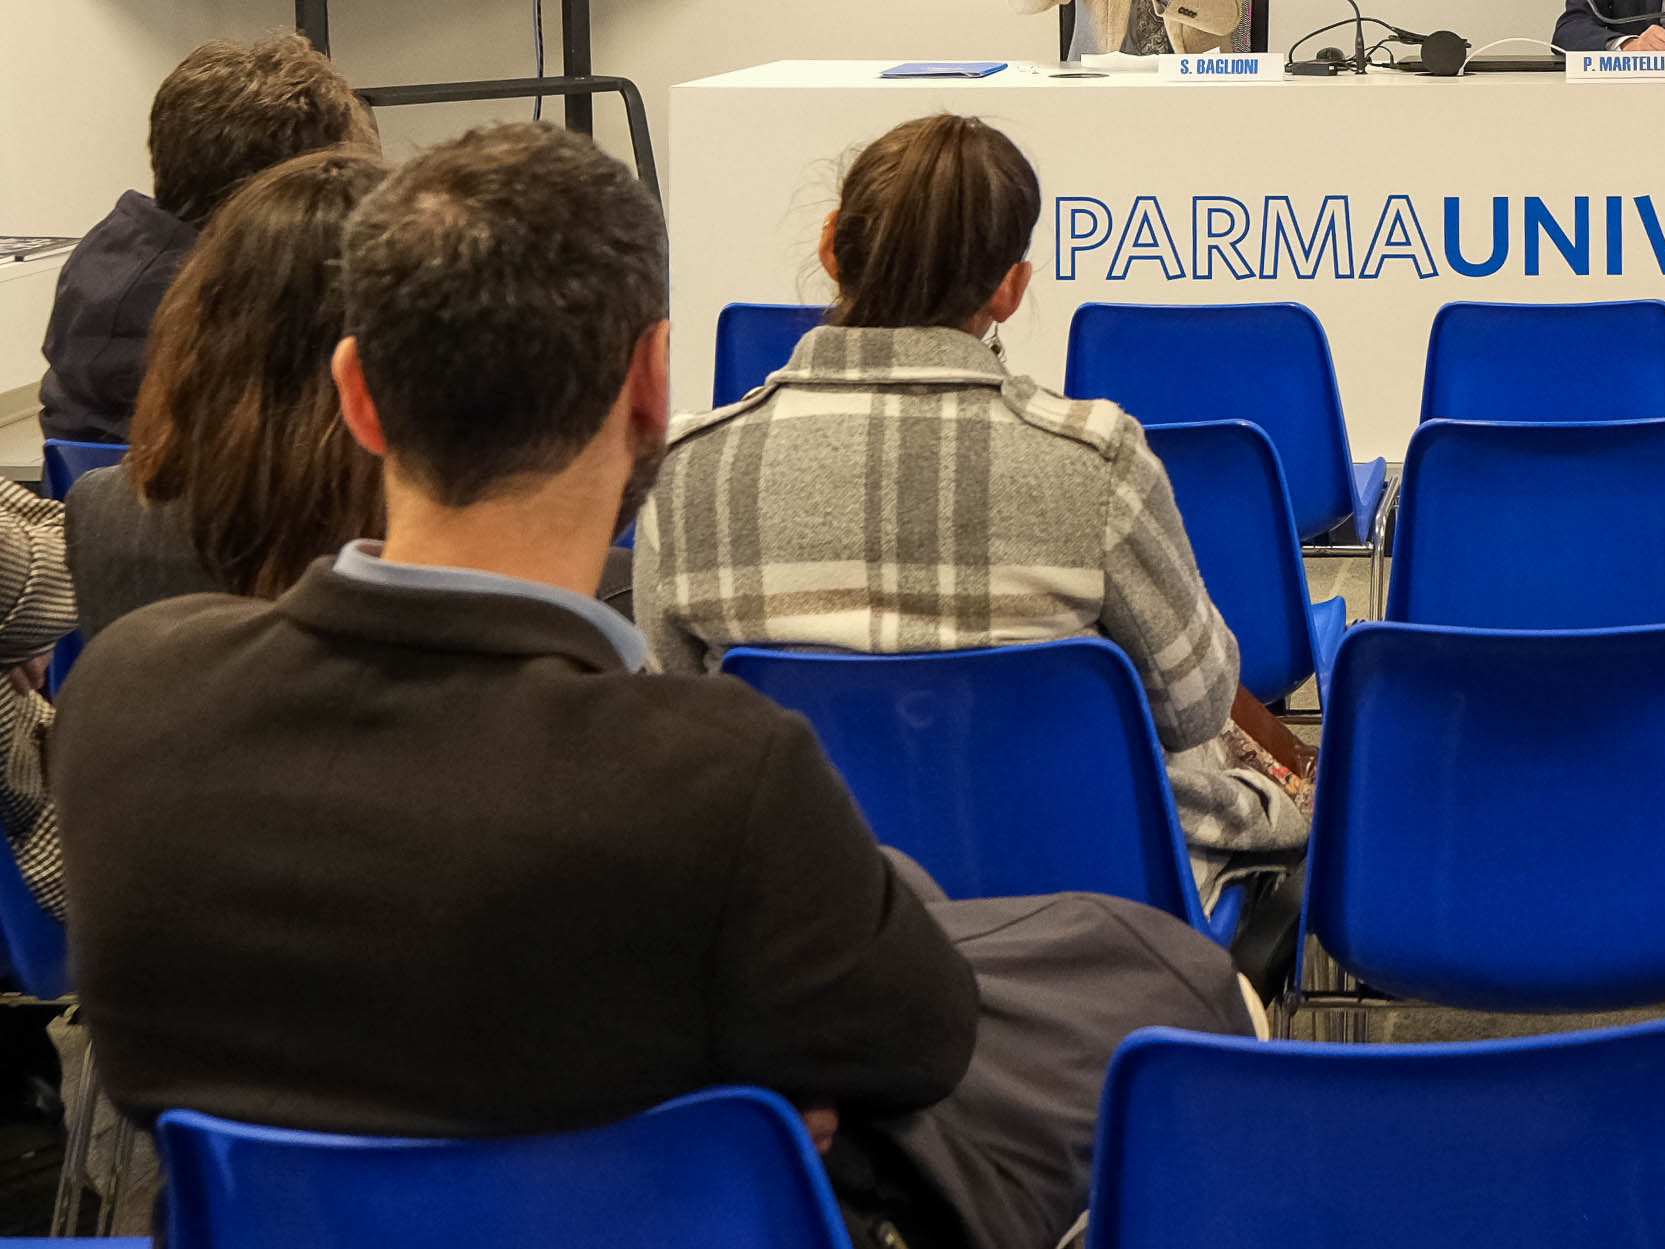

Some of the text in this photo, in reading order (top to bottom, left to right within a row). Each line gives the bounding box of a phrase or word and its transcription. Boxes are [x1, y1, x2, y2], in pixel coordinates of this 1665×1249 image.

[1180, 58, 1259, 75] S. BAGLIONI
[1583, 55, 1665, 72] P. MARTELLI
